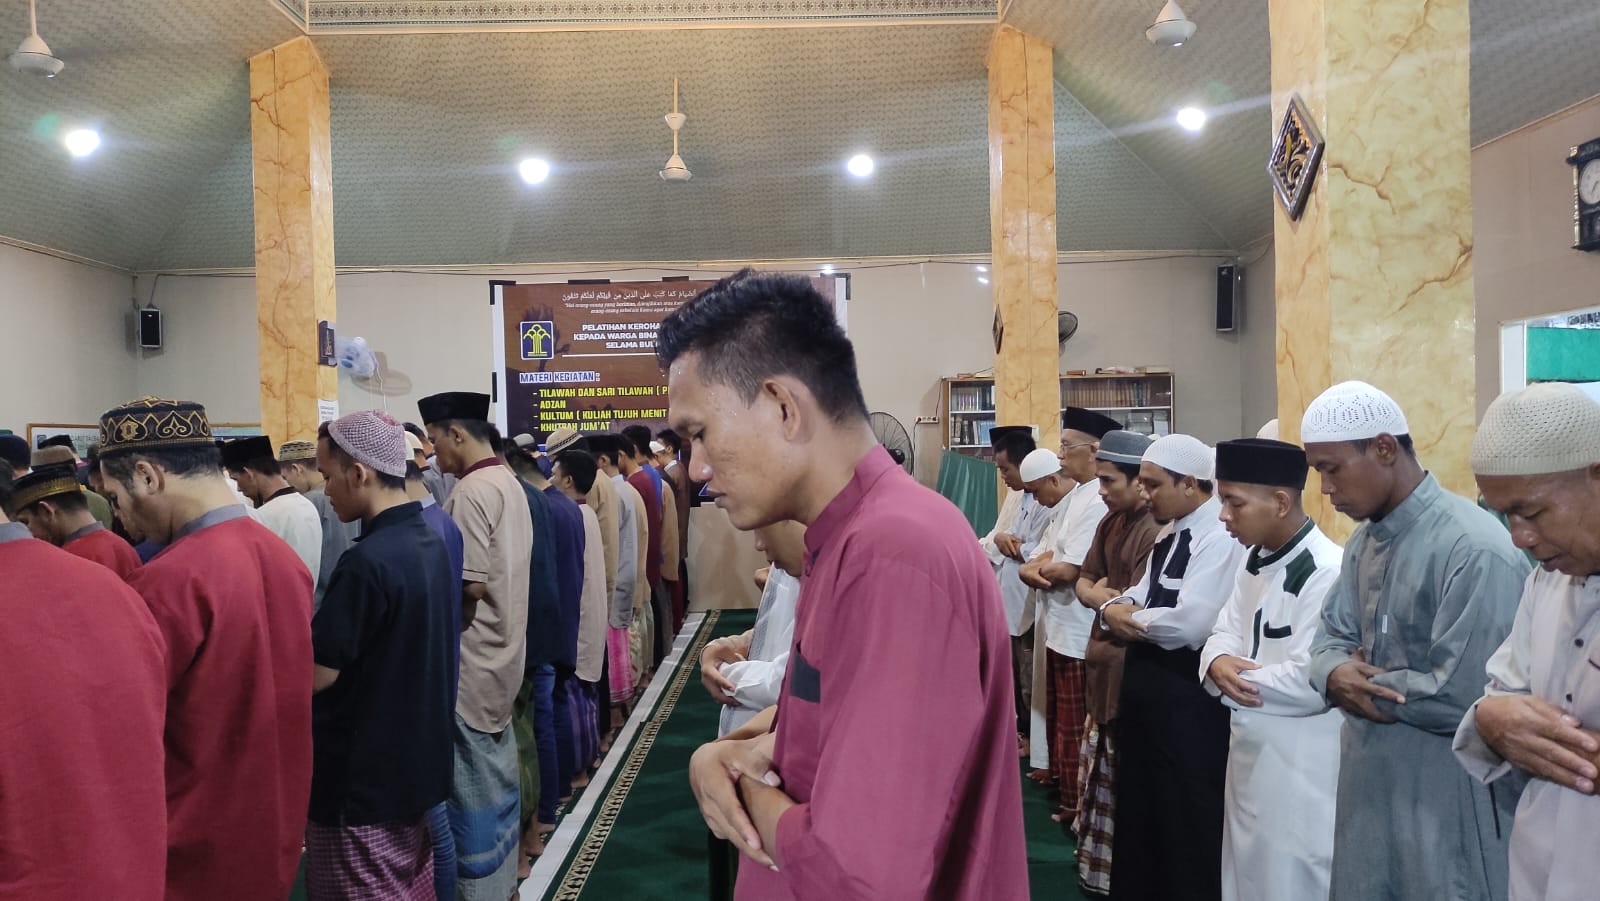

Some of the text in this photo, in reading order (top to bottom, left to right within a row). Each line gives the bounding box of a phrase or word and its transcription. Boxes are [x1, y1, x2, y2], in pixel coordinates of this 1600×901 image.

[573, 333, 606, 341] KEPADA
[606, 332, 638, 340] WARGA
[605, 341, 638, 349] SELAMA
[520, 372, 552, 383] MATERI
[539, 388, 576, 398] TILAWAH
[577, 388, 595, 397] DAN
[596, 387, 615, 396] SARI
[617, 386, 654, 396] TILAWAH
[540, 400, 567, 409] ADZAN
[540, 411, 574, 420] KULTUM
[582, 410, 611, 420] KULIAH
[613, 410, 639, 419] TUJUH
[640, 409, 668, 418] MENIT
[579, 421, 611, 431] JUM'AT
